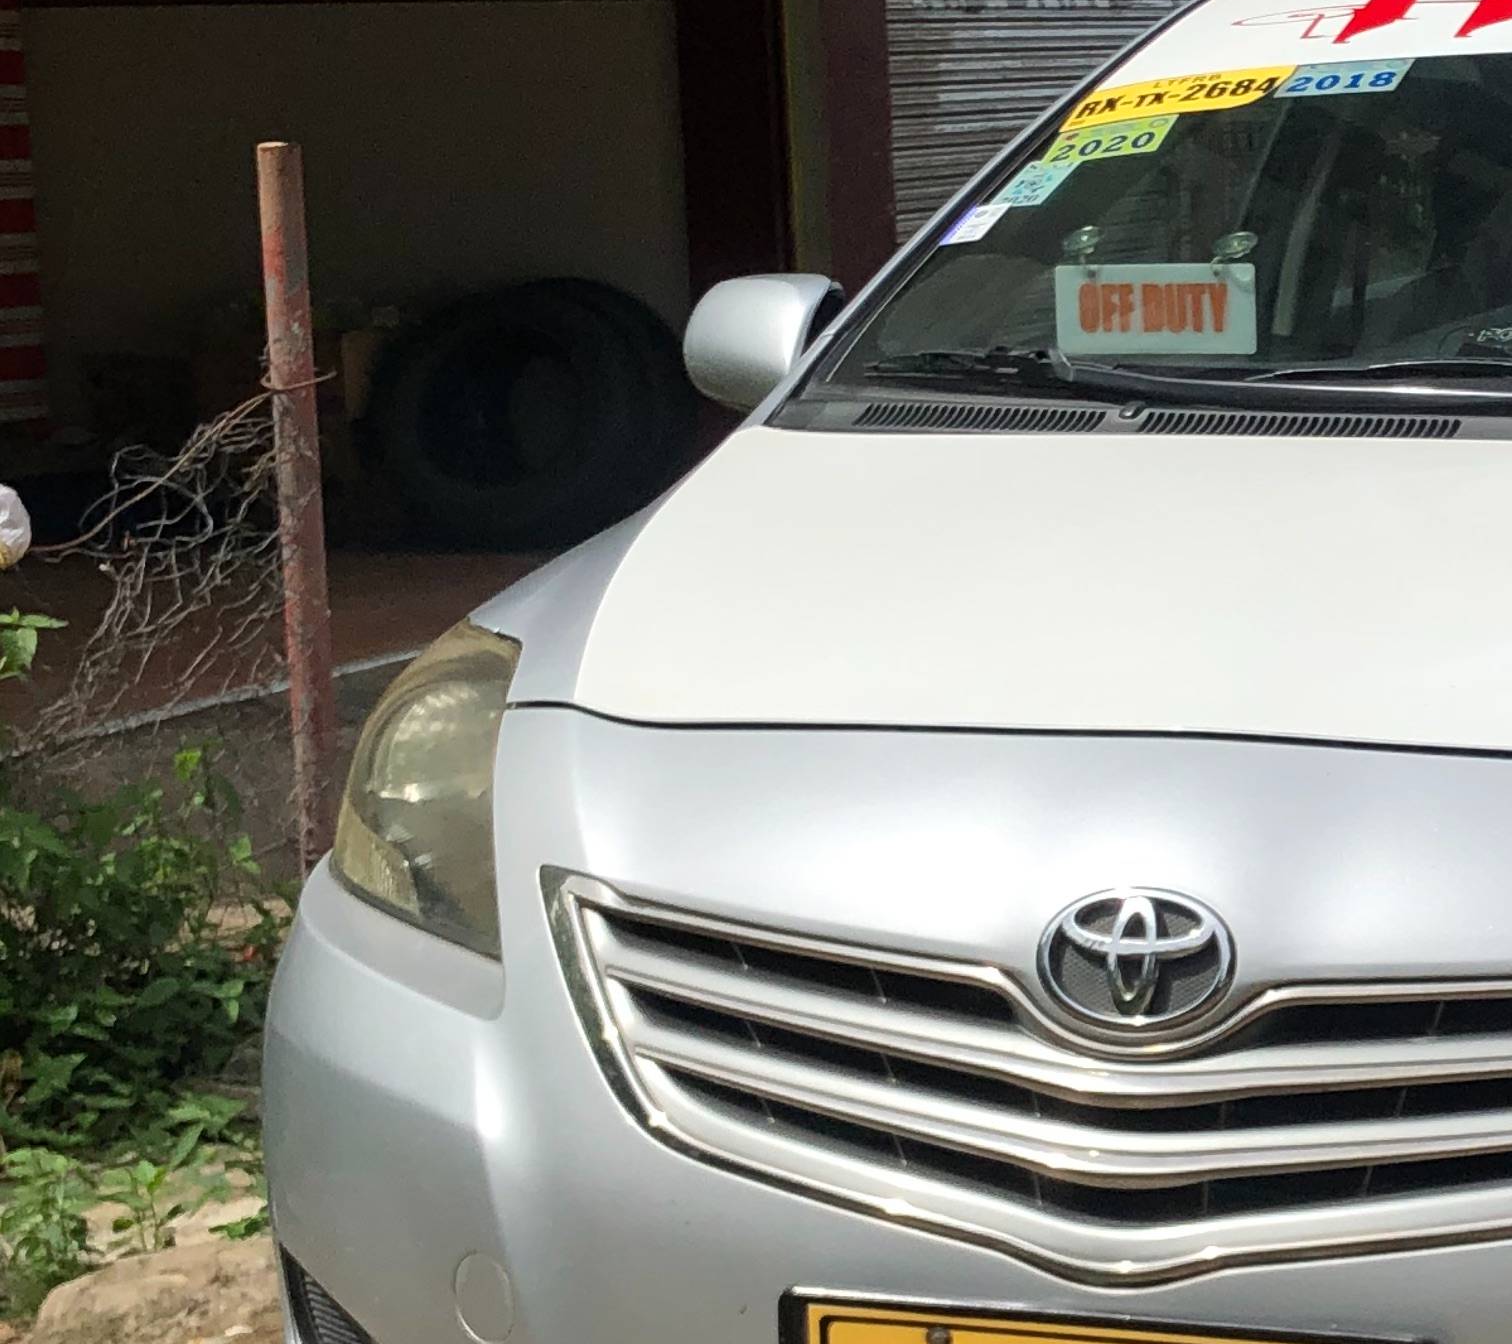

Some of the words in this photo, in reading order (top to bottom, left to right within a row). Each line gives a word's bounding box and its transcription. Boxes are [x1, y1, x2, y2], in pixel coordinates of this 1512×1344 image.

[1075, 76, 1280, 119] RX-TX-2684
[1286, 67, 1397, 93] 2018
[1050, 131, 1155, 162] 2020
[1079, 282, 1134, 334] OFF
[1142, 281, 1228, 334] DUTY
